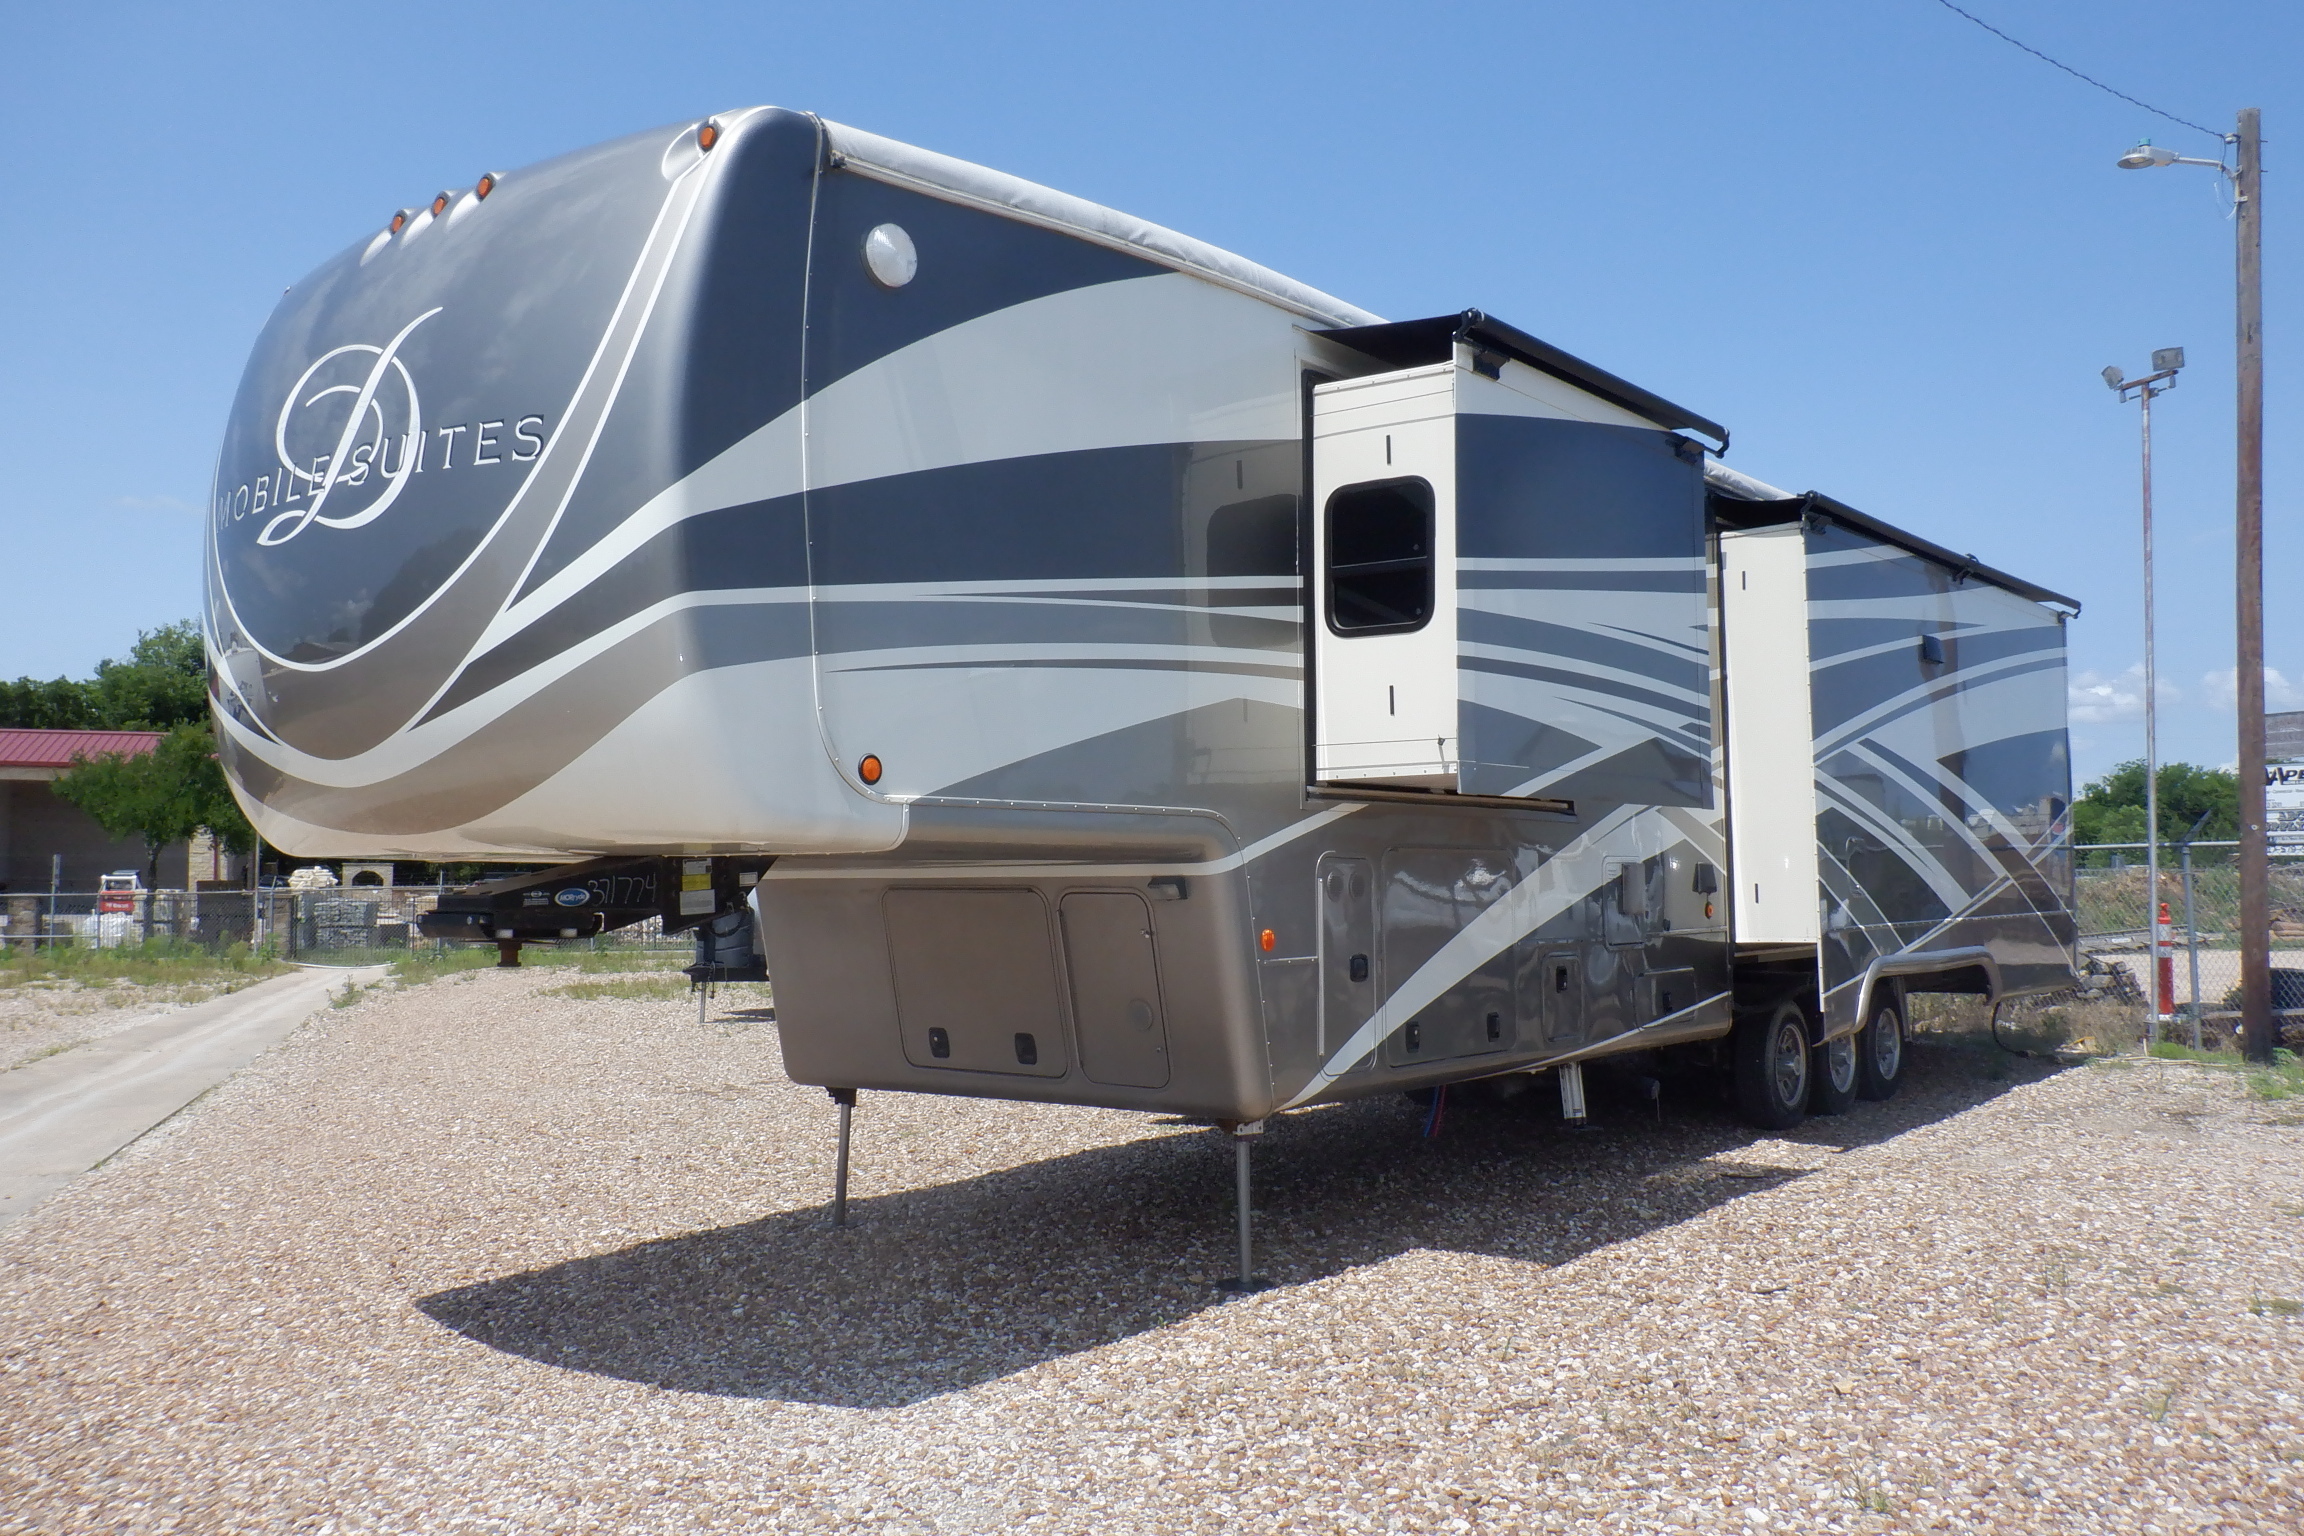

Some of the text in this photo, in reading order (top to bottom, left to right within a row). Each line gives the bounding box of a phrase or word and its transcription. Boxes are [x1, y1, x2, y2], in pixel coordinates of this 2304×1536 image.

[216, 414, 545, 533] MOBILE SUITES
[587, 872, 657, 907] 371774
